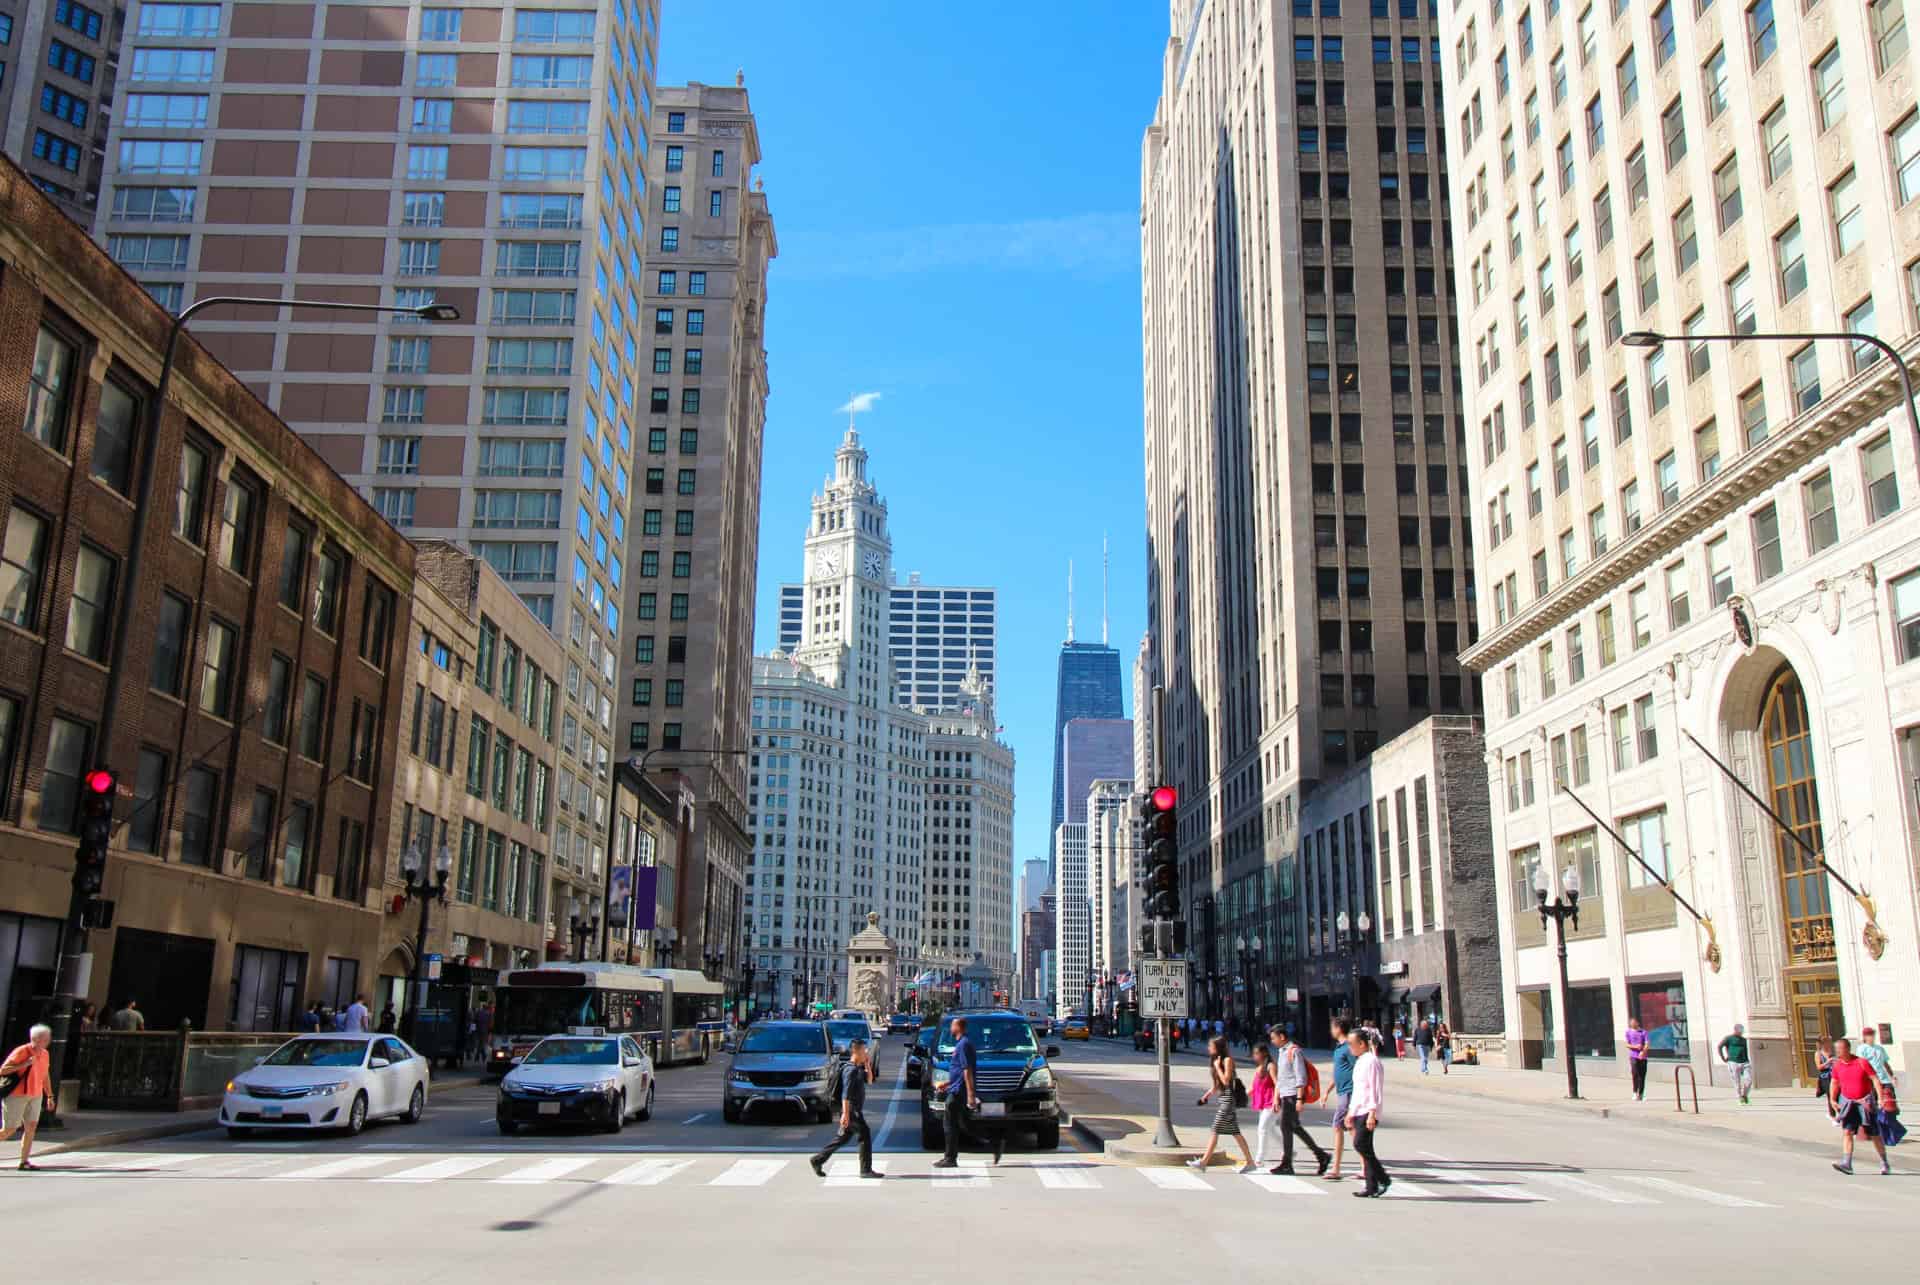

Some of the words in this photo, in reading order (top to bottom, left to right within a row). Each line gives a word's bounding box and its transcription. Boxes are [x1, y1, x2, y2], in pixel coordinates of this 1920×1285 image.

[1144, 965, 1164, 977] TURN
[1166, 965, 1184, 977] LEFT
[1159, 977, 1170, 986] ON
[1144, 987, 1160, 998] LEFT
[1162, 987, 1184, 998] ARROW
